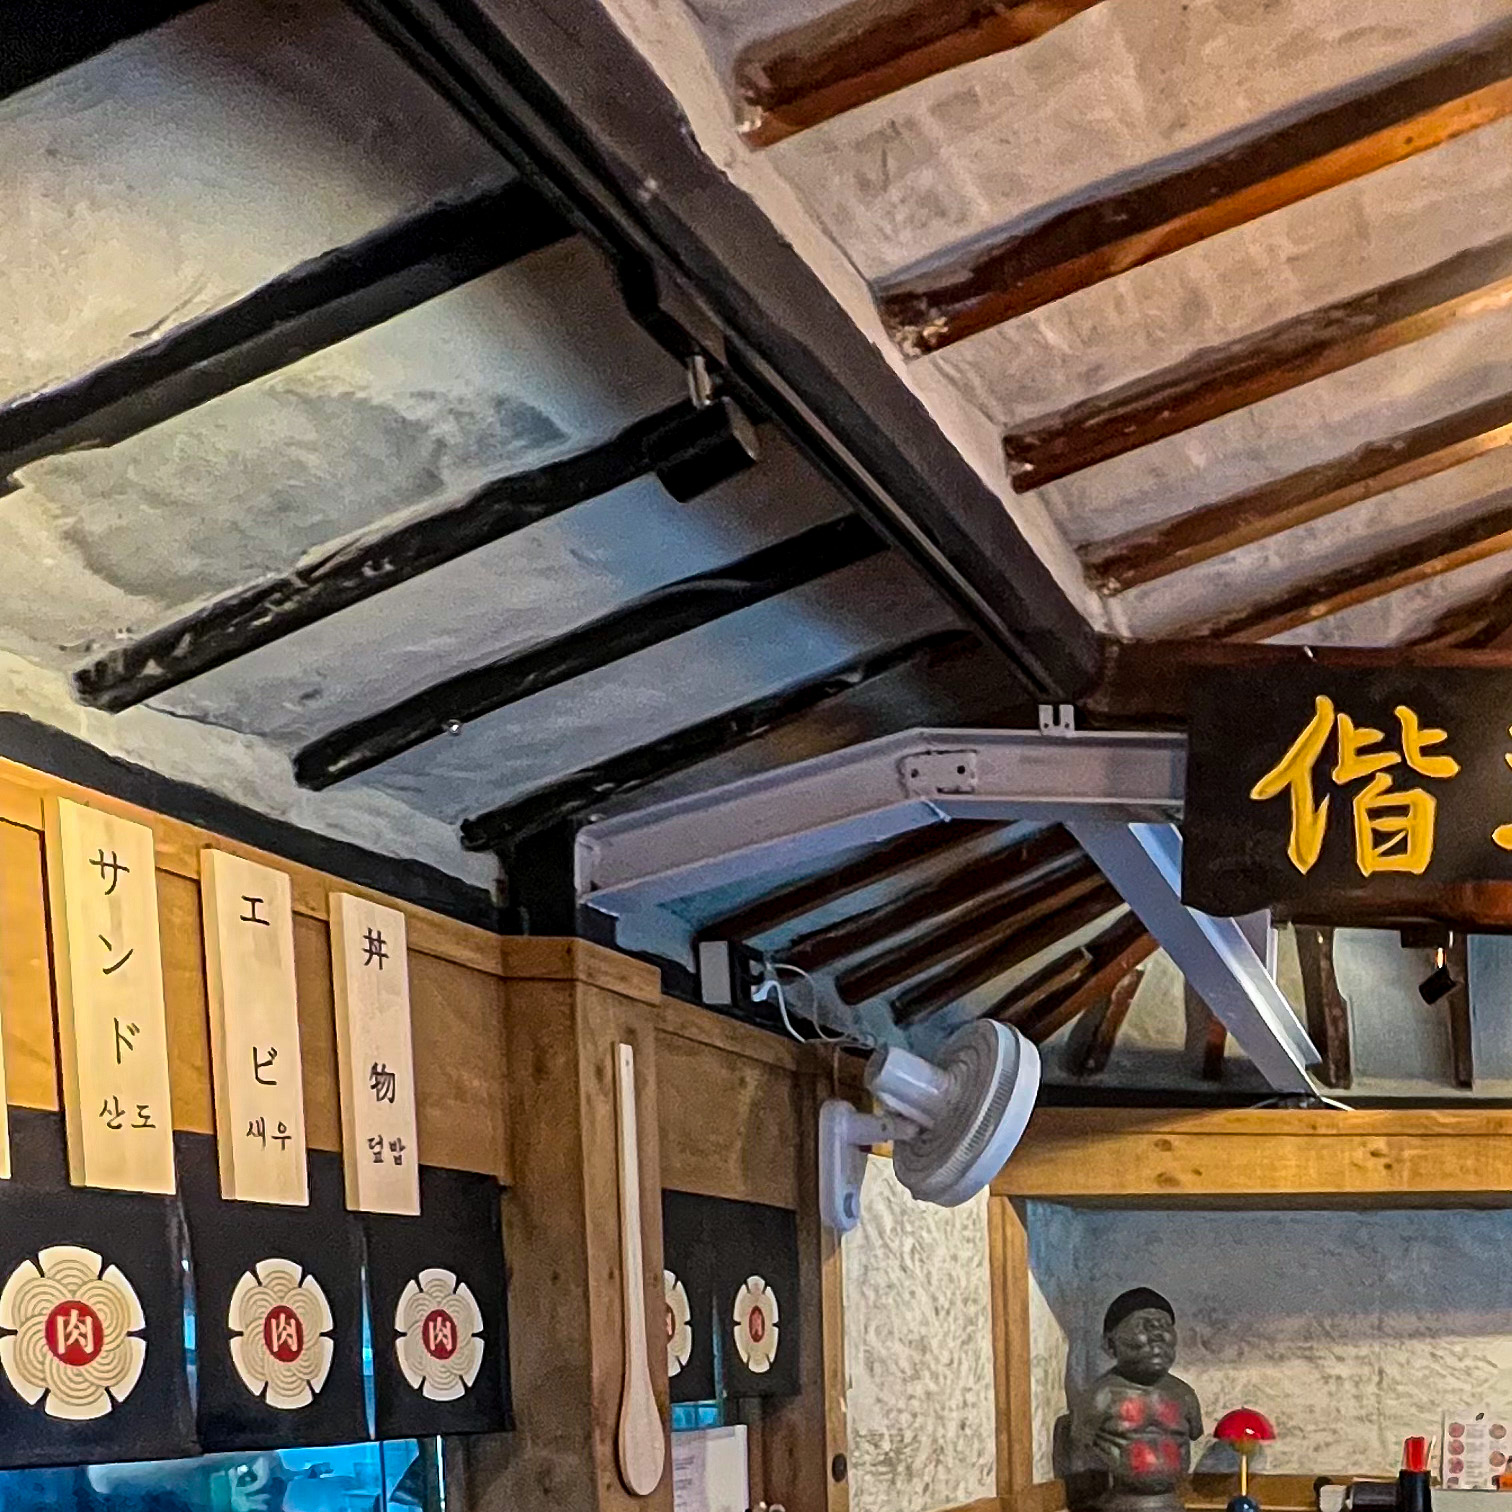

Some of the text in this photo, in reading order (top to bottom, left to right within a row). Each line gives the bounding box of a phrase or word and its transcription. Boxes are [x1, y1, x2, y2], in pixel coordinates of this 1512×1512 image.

[89, 849, 140, 1065] サンド
[239, 895, 278, 1086] エビ
[99, 1095, 156, 1129] 산도
[246, 1116, 292, 1151] 새우
[56, 1307, 96, 1354] 肉
[270, 1312, 300, 1352] 肉
[428, 1316, 453, 1350] 肉
